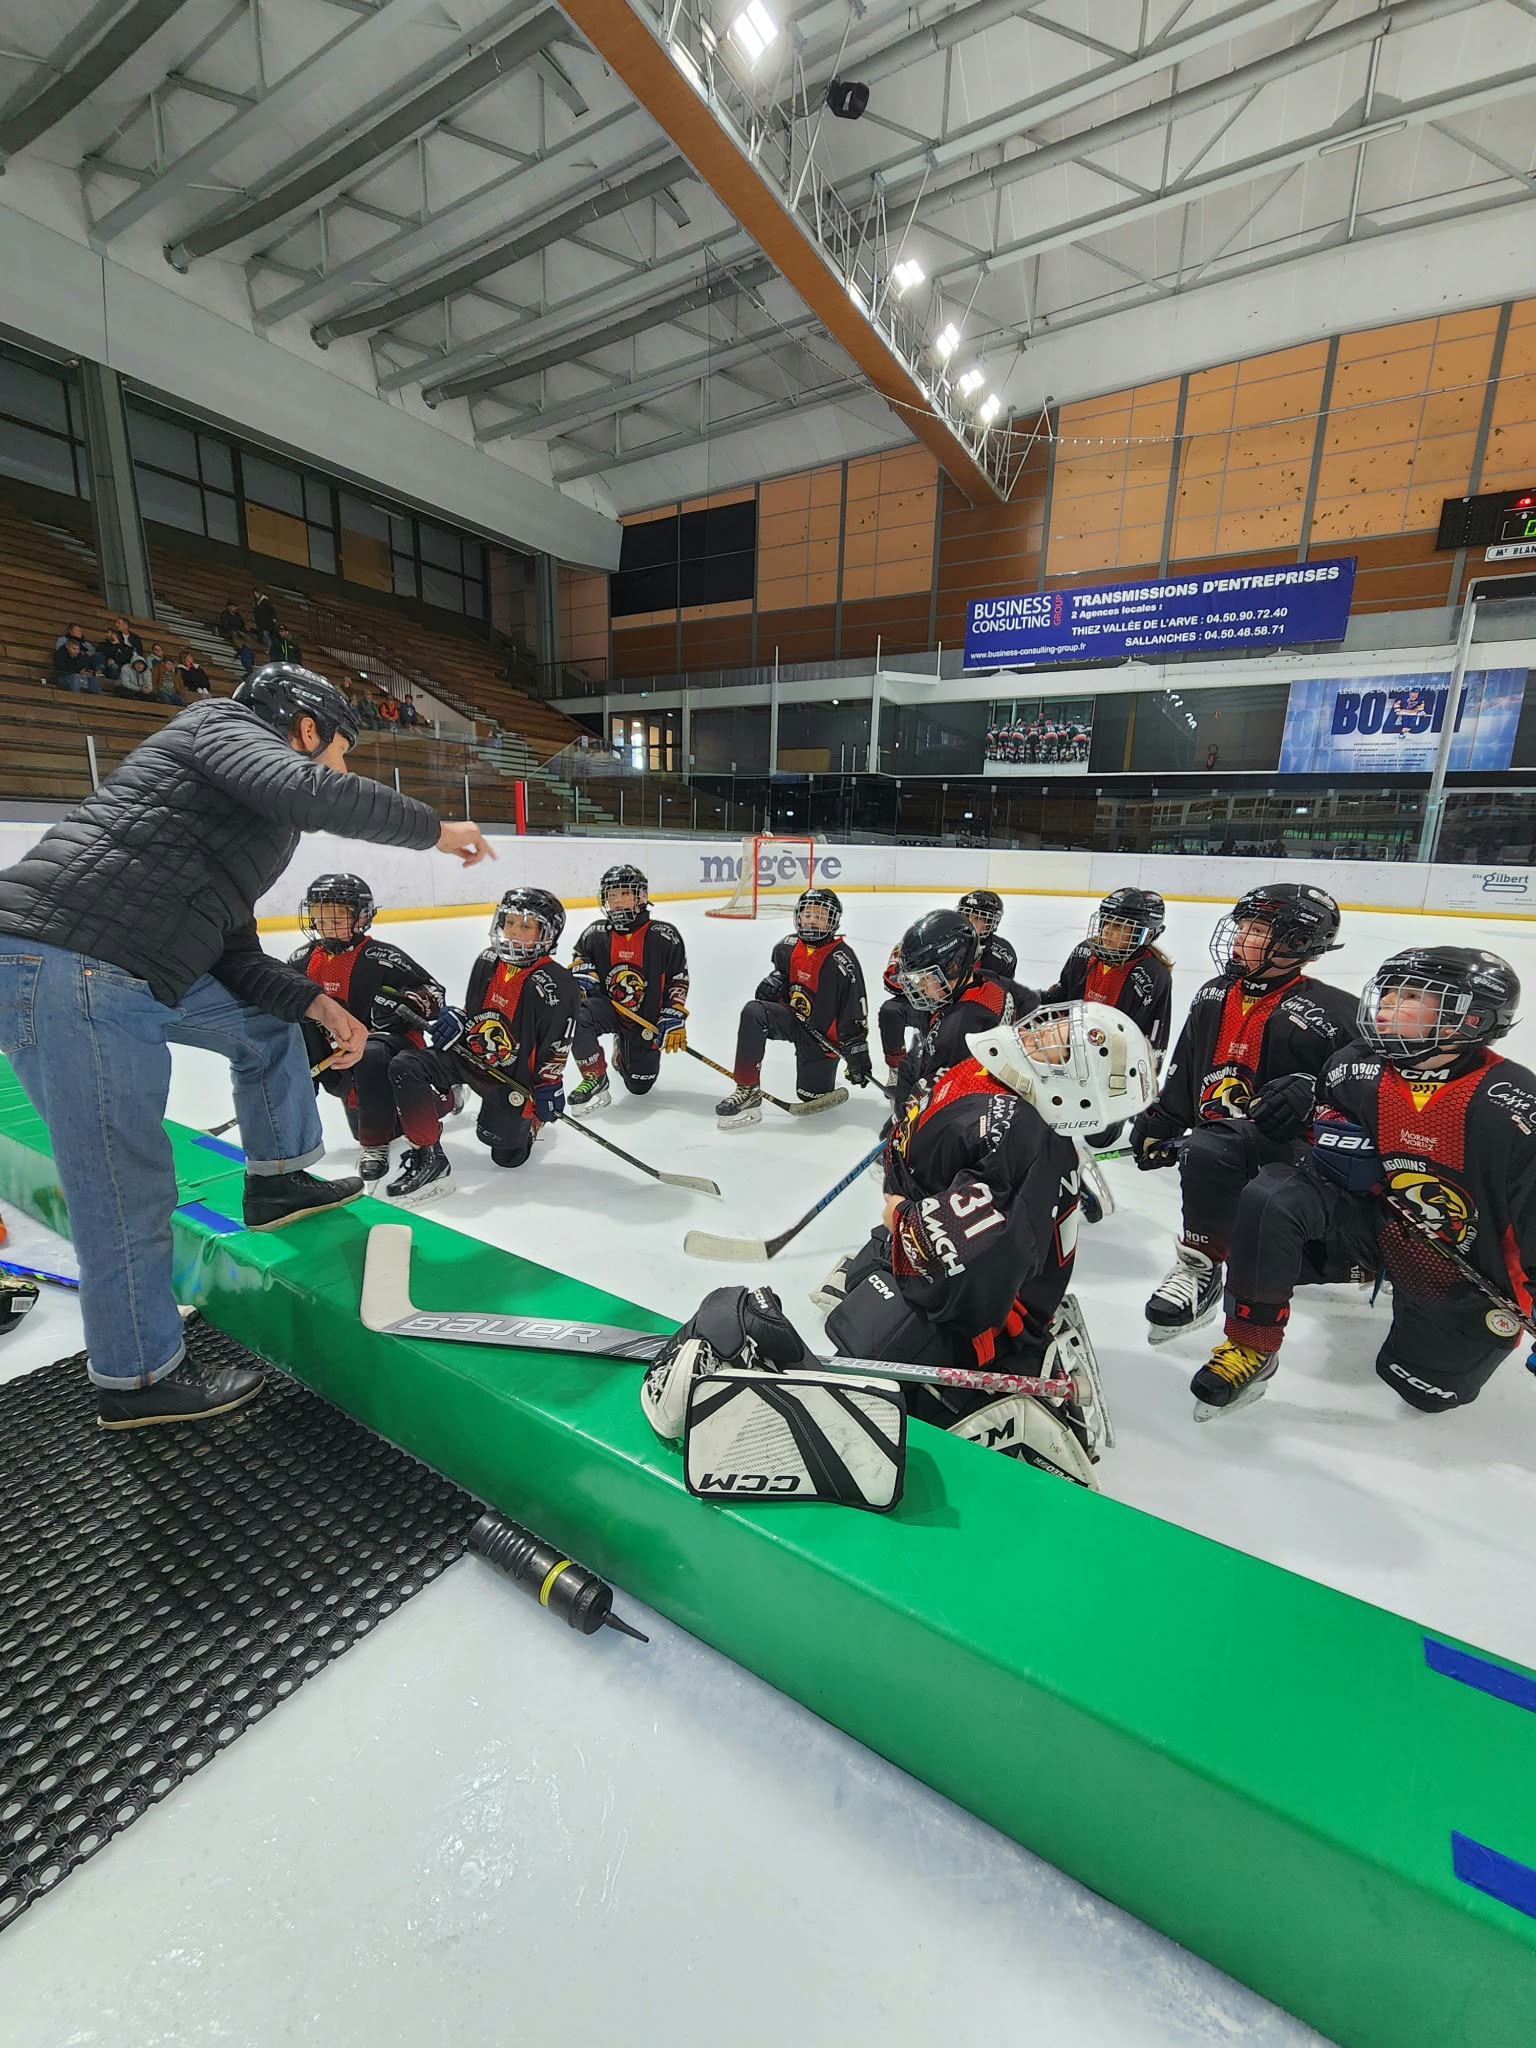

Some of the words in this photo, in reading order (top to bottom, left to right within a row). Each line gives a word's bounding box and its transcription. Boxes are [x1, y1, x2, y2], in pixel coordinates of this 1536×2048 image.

[1073, 583, 1198, 607] TRANSMISSIONS
[1203, 567, 1340, 593] D'ENTREPRISES
[974, 596, 1051, 620] BUSINESS
[1053, 594, 1063, 626] GROUP
[1071, 611, 1078, 619] 2
[1079, 608, 1119, 620] Agences
[1122, 604, 1157, 615] locales
[972, 614, 1051, 634] CONSULTING
[1072, 626, 1100, 636] THIEZ
[1103, 619, 1141, 635] VALLÉE
[1144, 620, 1158, 629] DE
[1160, 616, 1198, 628] L'ARVE
[1206, 607, 1288, 624] 04.50.90.72.40
[1125, 633, 1196, 647] SALLANCHES
[1204, 625, 1284, 640] 04.50.48.58.71
[970, 642, 1086, 660] www.business-consulting-group.fr
[949, 1182, 1006, 1239] 31
[921, 1197, 966, 1277] AMCH
[868, 1274, 895, 1300] CCM
[398, 1316, 601, 1343] BAUER
[1389, 1363, 1458, 1400] CCM
[698, 1473, 801, 1492] CCM
